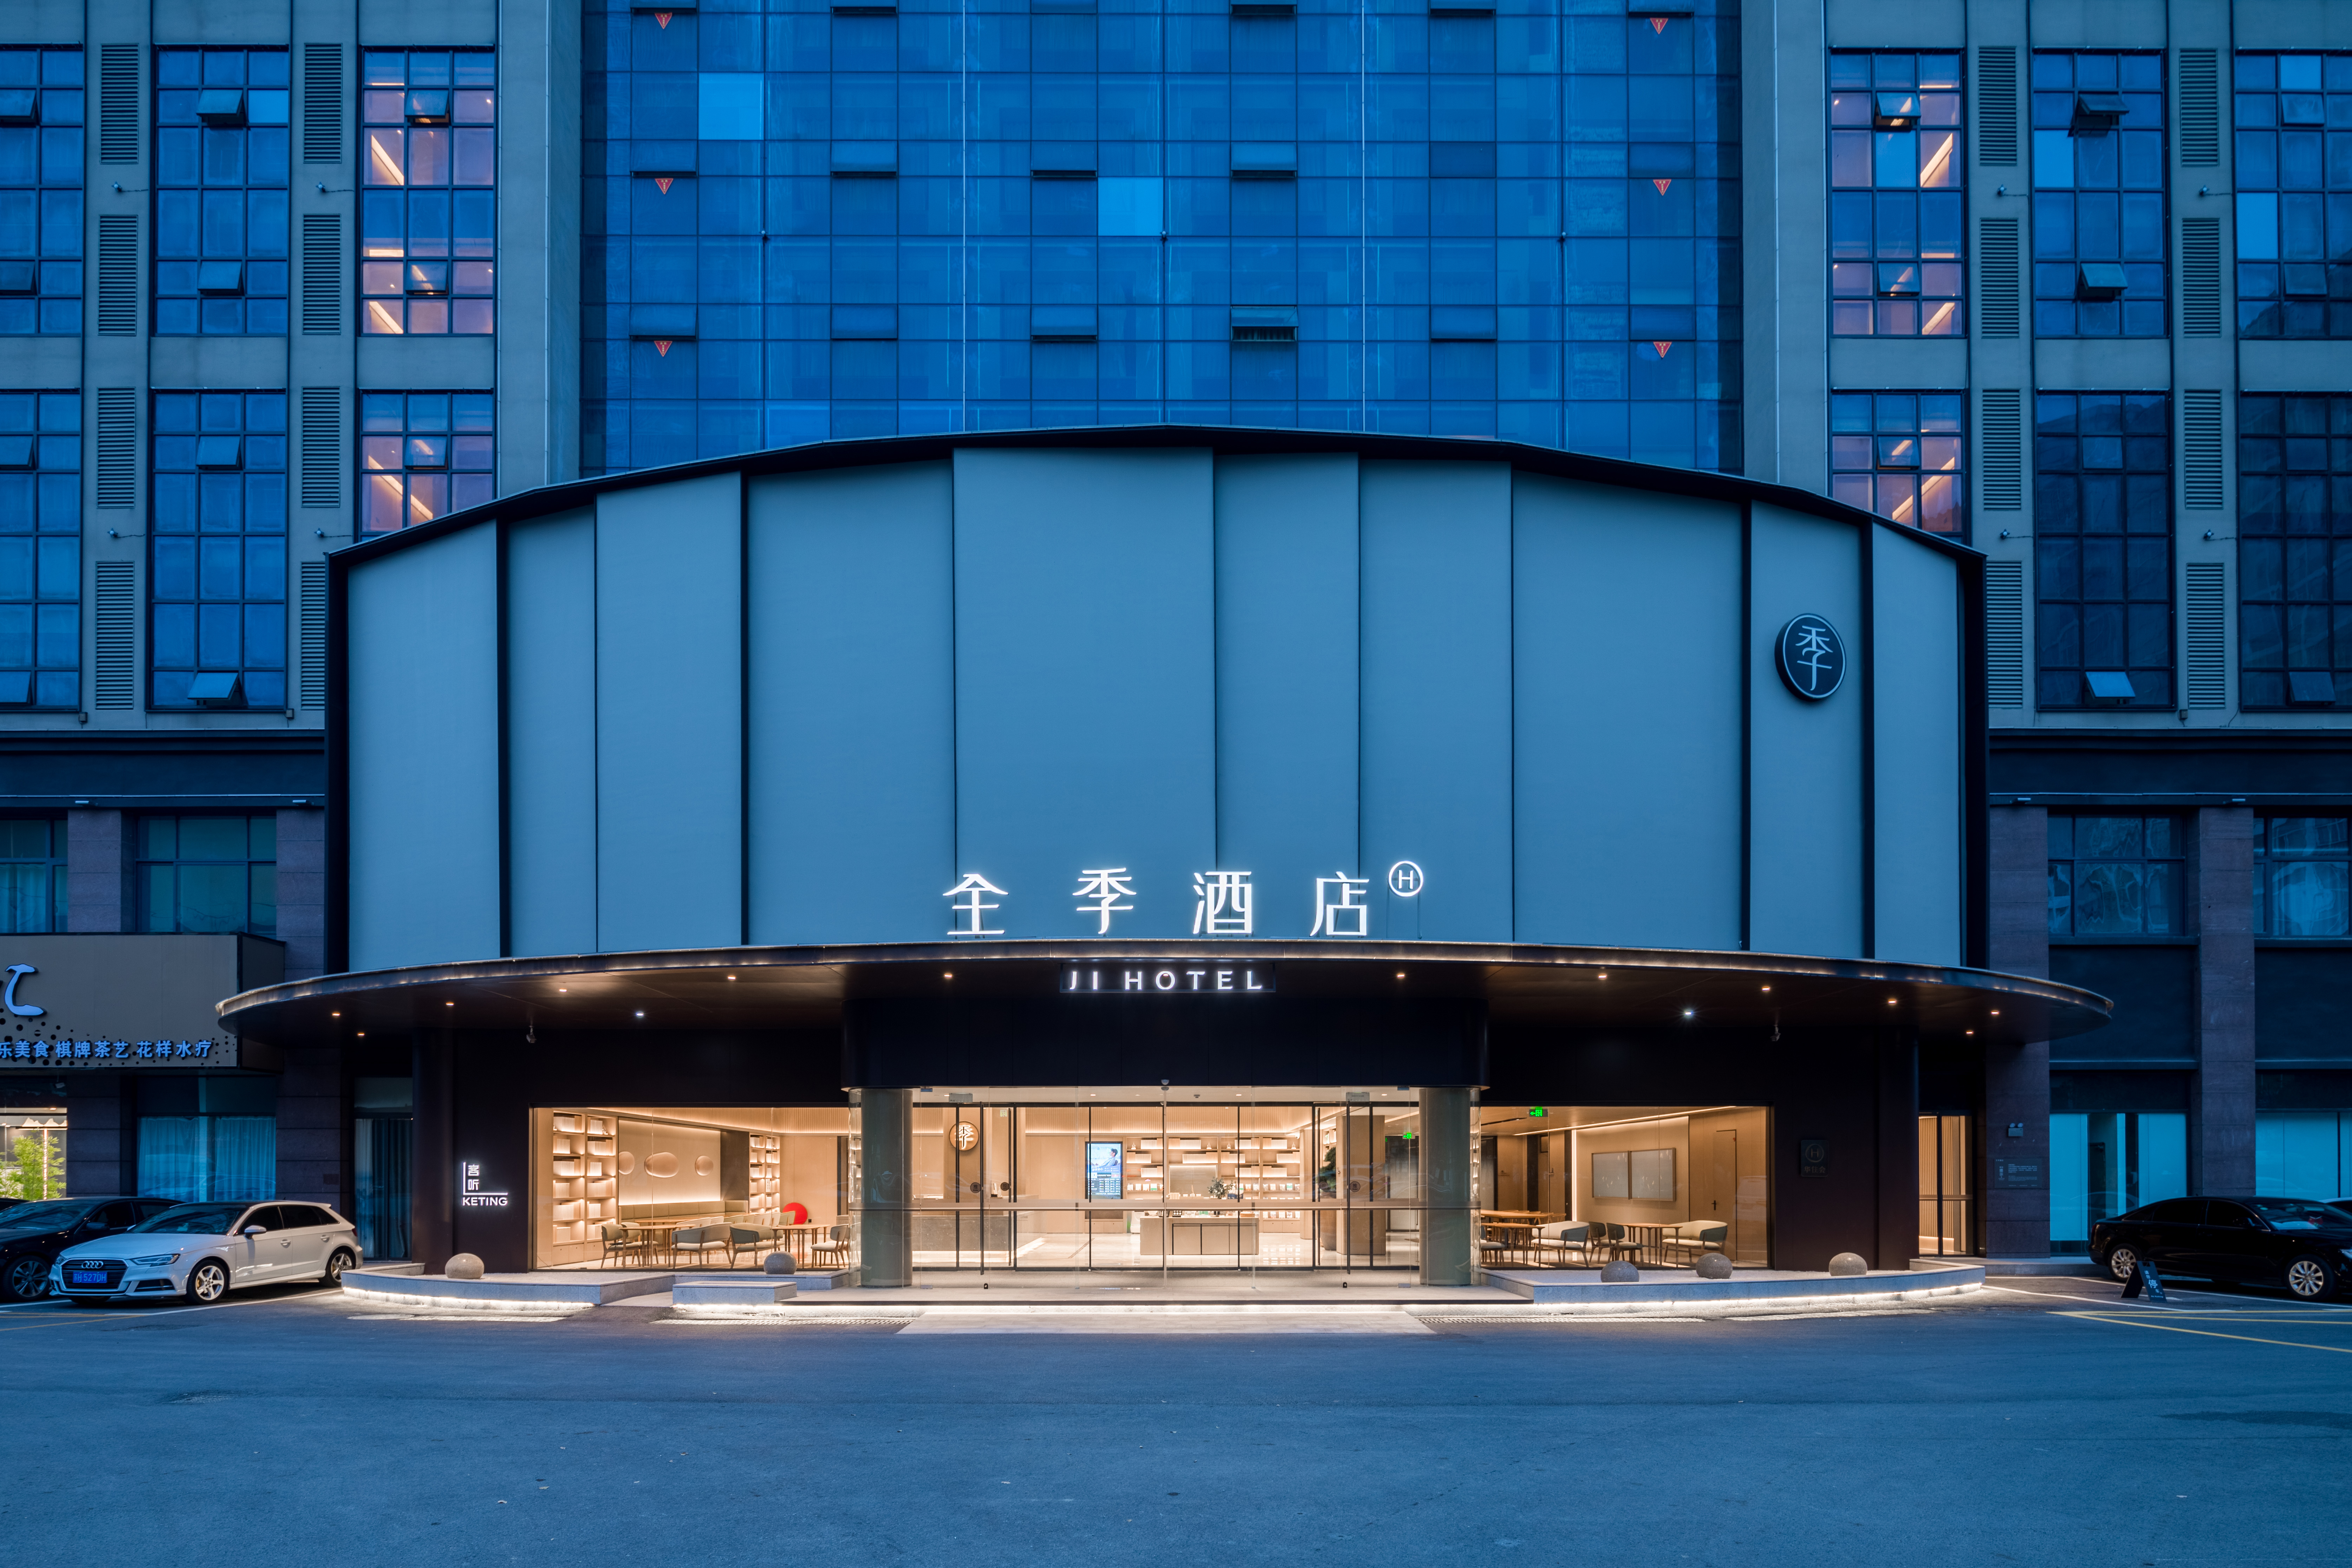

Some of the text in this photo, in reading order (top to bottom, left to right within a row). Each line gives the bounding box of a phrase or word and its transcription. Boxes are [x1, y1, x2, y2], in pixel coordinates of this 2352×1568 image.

[1795, 625, 1833, 691] 季
[943, 867, 1370, 936] 全季酒店
[1070, 971, 1262, 990] JI HOTEL
[55, 1040, 129, 1058] 棋牌茶艺
[136, 1040, 212, 1058] 花样水疗
[462, 1197, 508, 1206] KETING
